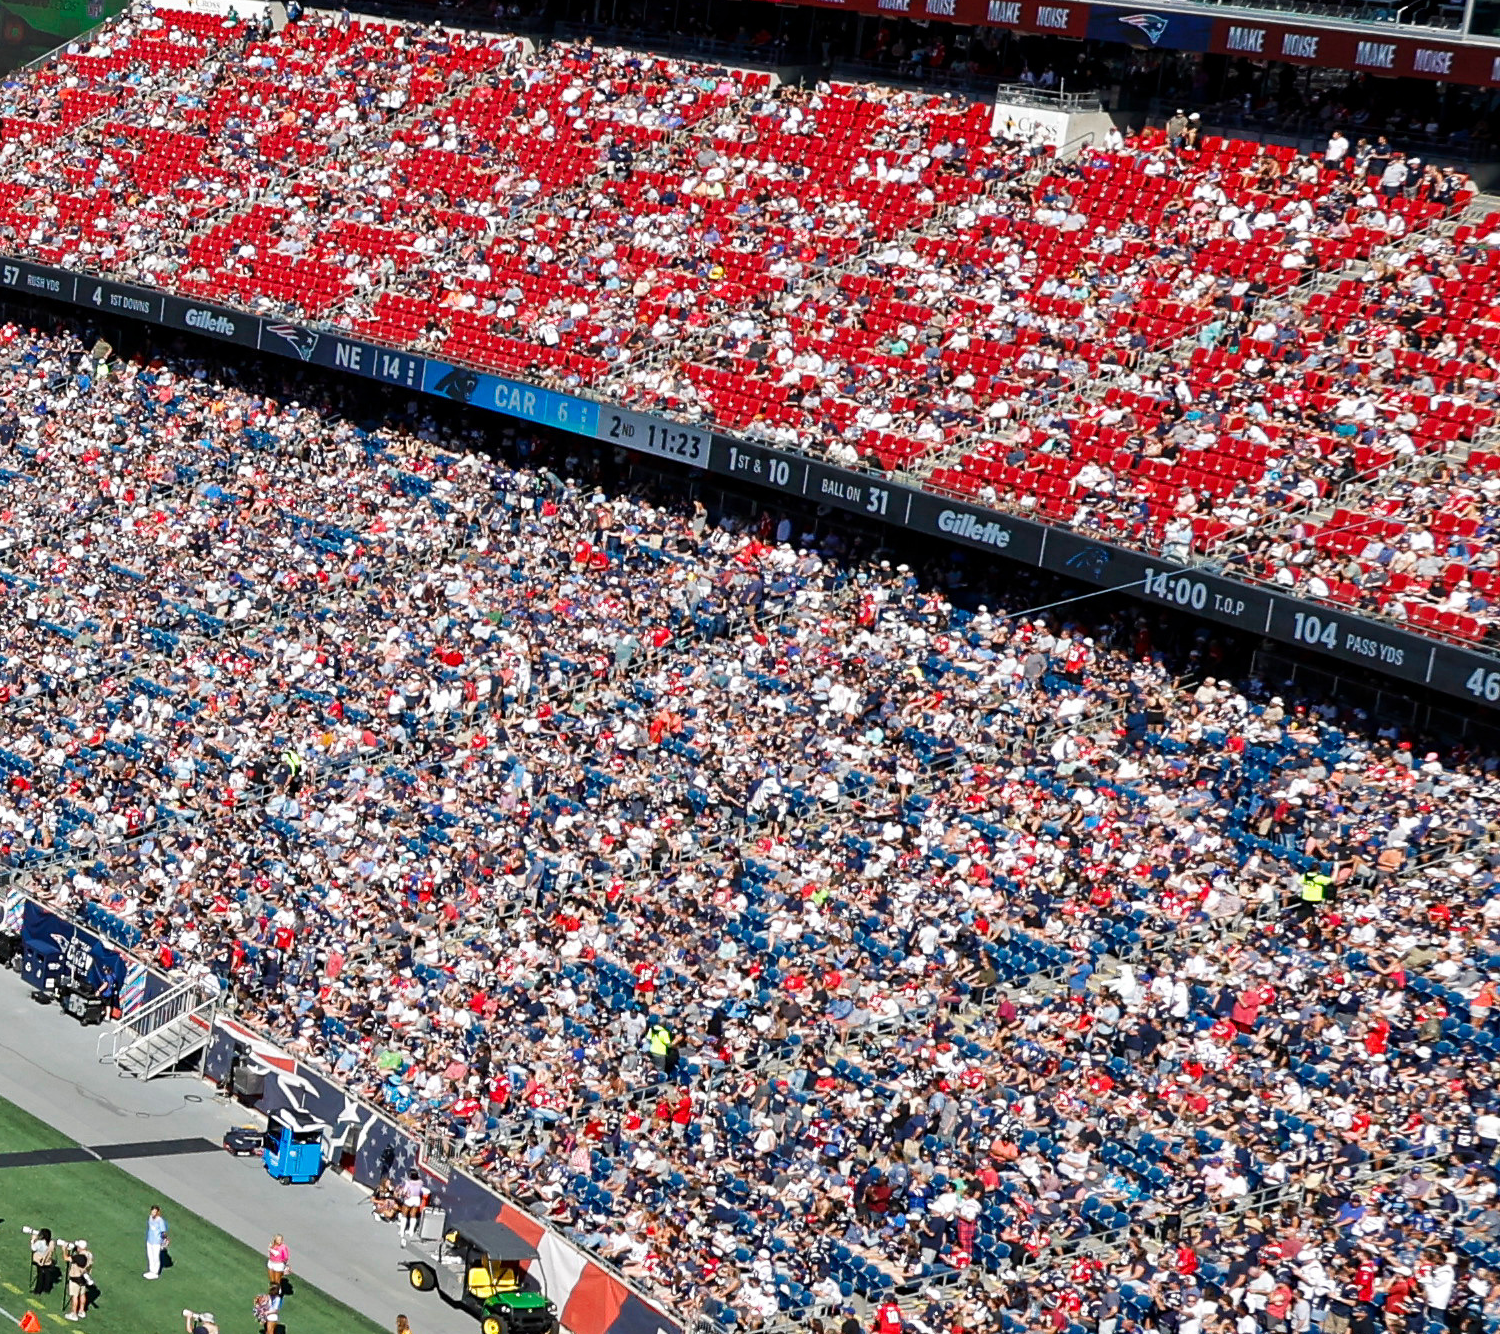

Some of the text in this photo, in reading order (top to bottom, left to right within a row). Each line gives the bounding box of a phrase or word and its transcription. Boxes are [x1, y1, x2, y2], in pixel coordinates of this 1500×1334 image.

[184, 307, 235, 337] Gillette
[335, 342, 362, 370] NE
[383, 355, 400, 379] 14
[494, 384, 536, 417] CAR
[557, 402, 568, 423] 6
[648, 423, 701, 459] 11:23
[1143, 568, 1404, 666] 14:00 T.O.P 104 PASS YDS
